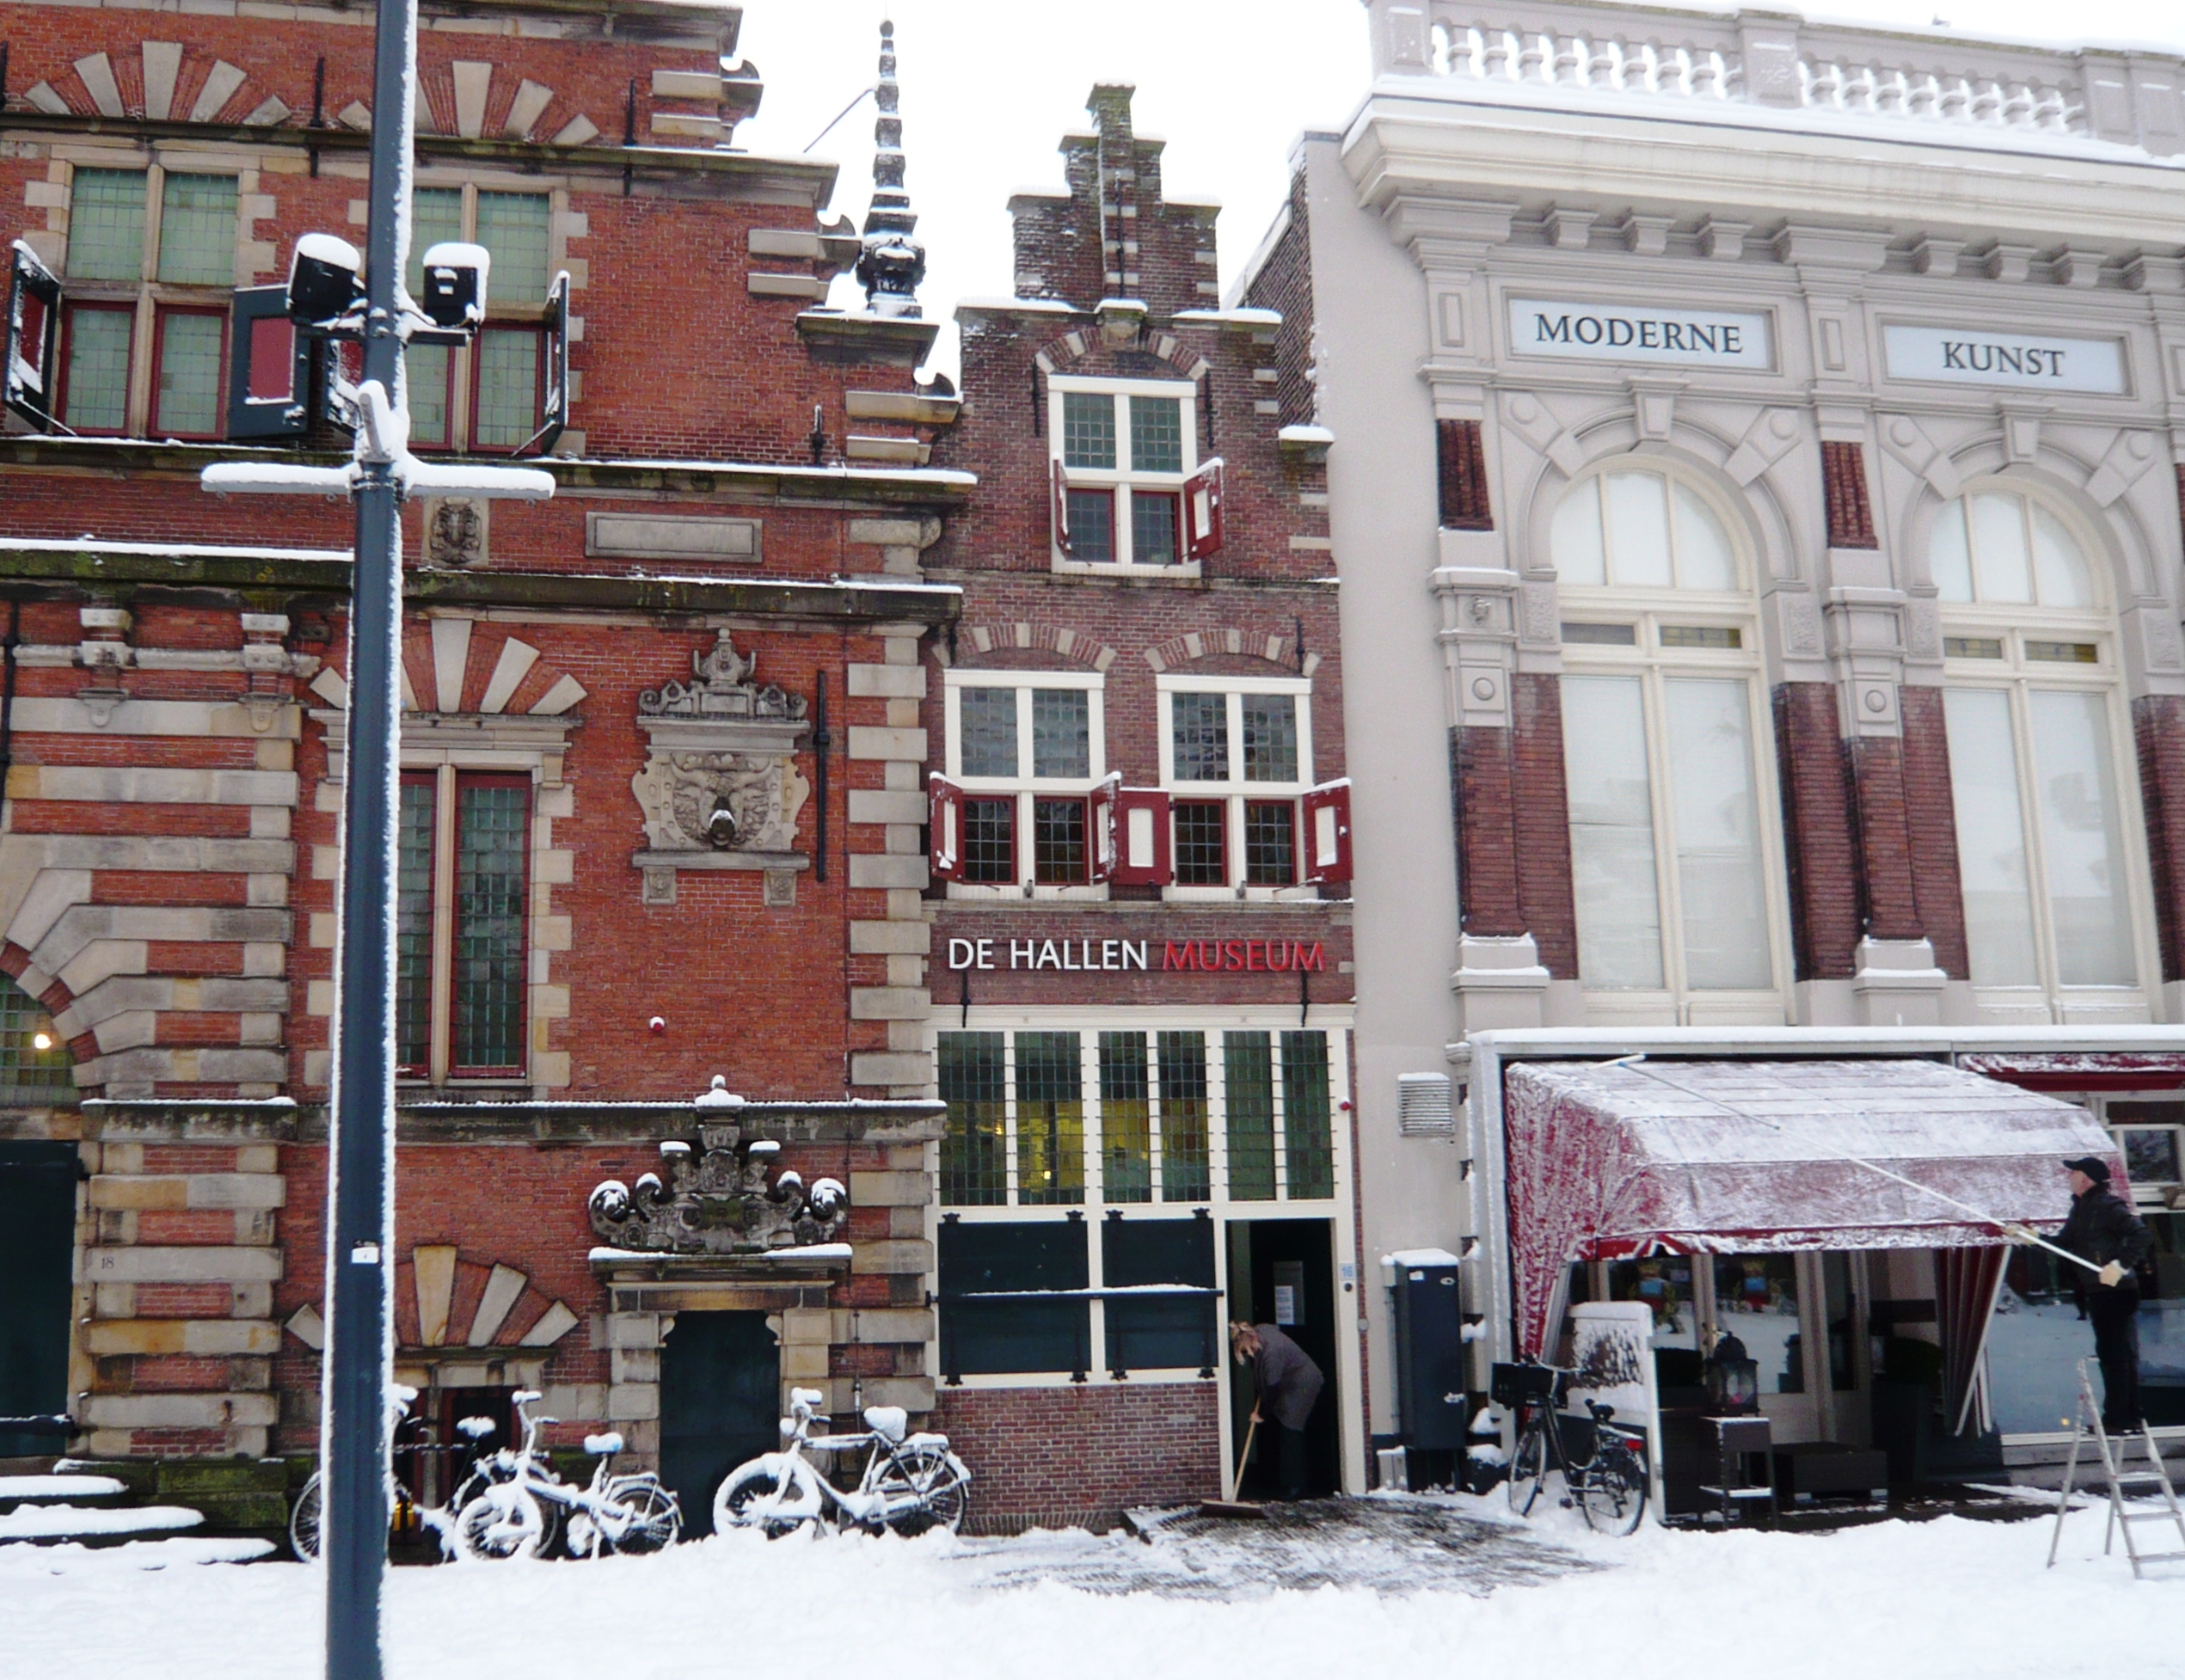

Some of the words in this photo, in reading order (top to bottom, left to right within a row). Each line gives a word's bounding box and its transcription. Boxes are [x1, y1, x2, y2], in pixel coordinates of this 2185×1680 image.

[1534, 313, 1744, 353] MODERNE
[1941, 341, 2065, 377] KUNST
[948, 938, 995, 969] DE
[1010, 939, 1147, 970] HALLEN
[1163, 940, 1327, 972] MUSEUM
[101, 1256, 114, 1269] 18
